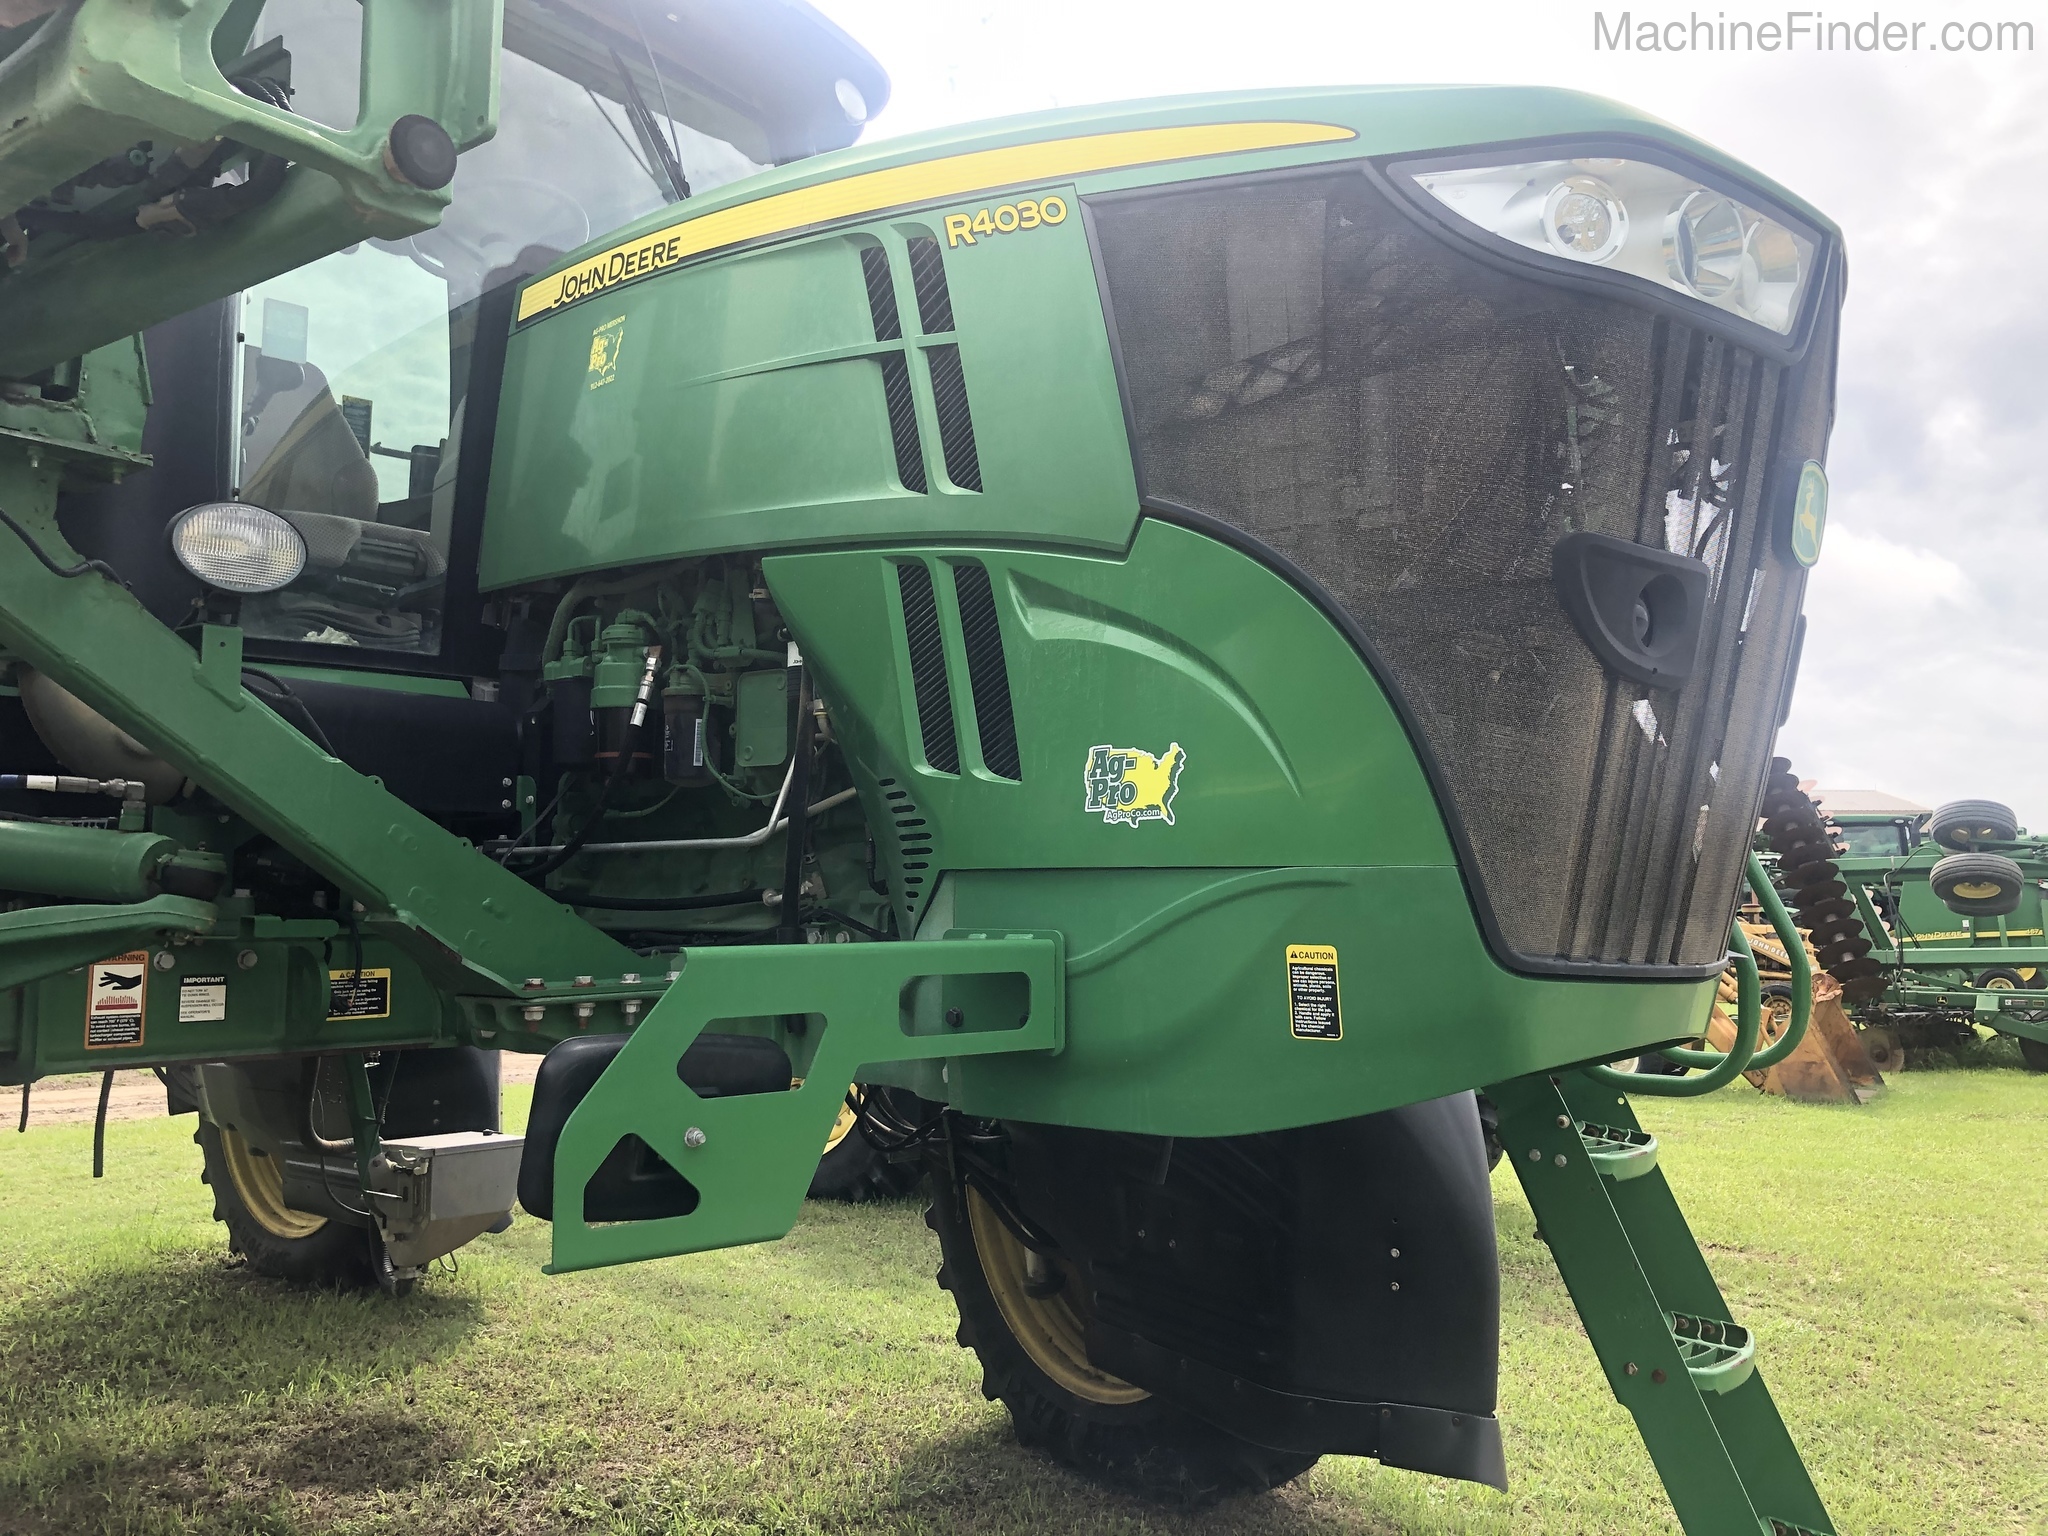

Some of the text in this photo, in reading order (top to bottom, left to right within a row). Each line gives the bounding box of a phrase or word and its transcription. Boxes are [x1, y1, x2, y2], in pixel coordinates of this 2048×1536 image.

[944, 196, 1067, 249] R4030
[554, 236, 681, 304] JOHN DEERE
[1089, 749, 1136, 783] Ag-
[1089, 778, 1137, 807] Pro
[1106, 809, 1161, 820] AgProCo.com
[1298, 951, 1334, 960] CAUTION
[1748, 938, 1790, 960] JOHN DEE
